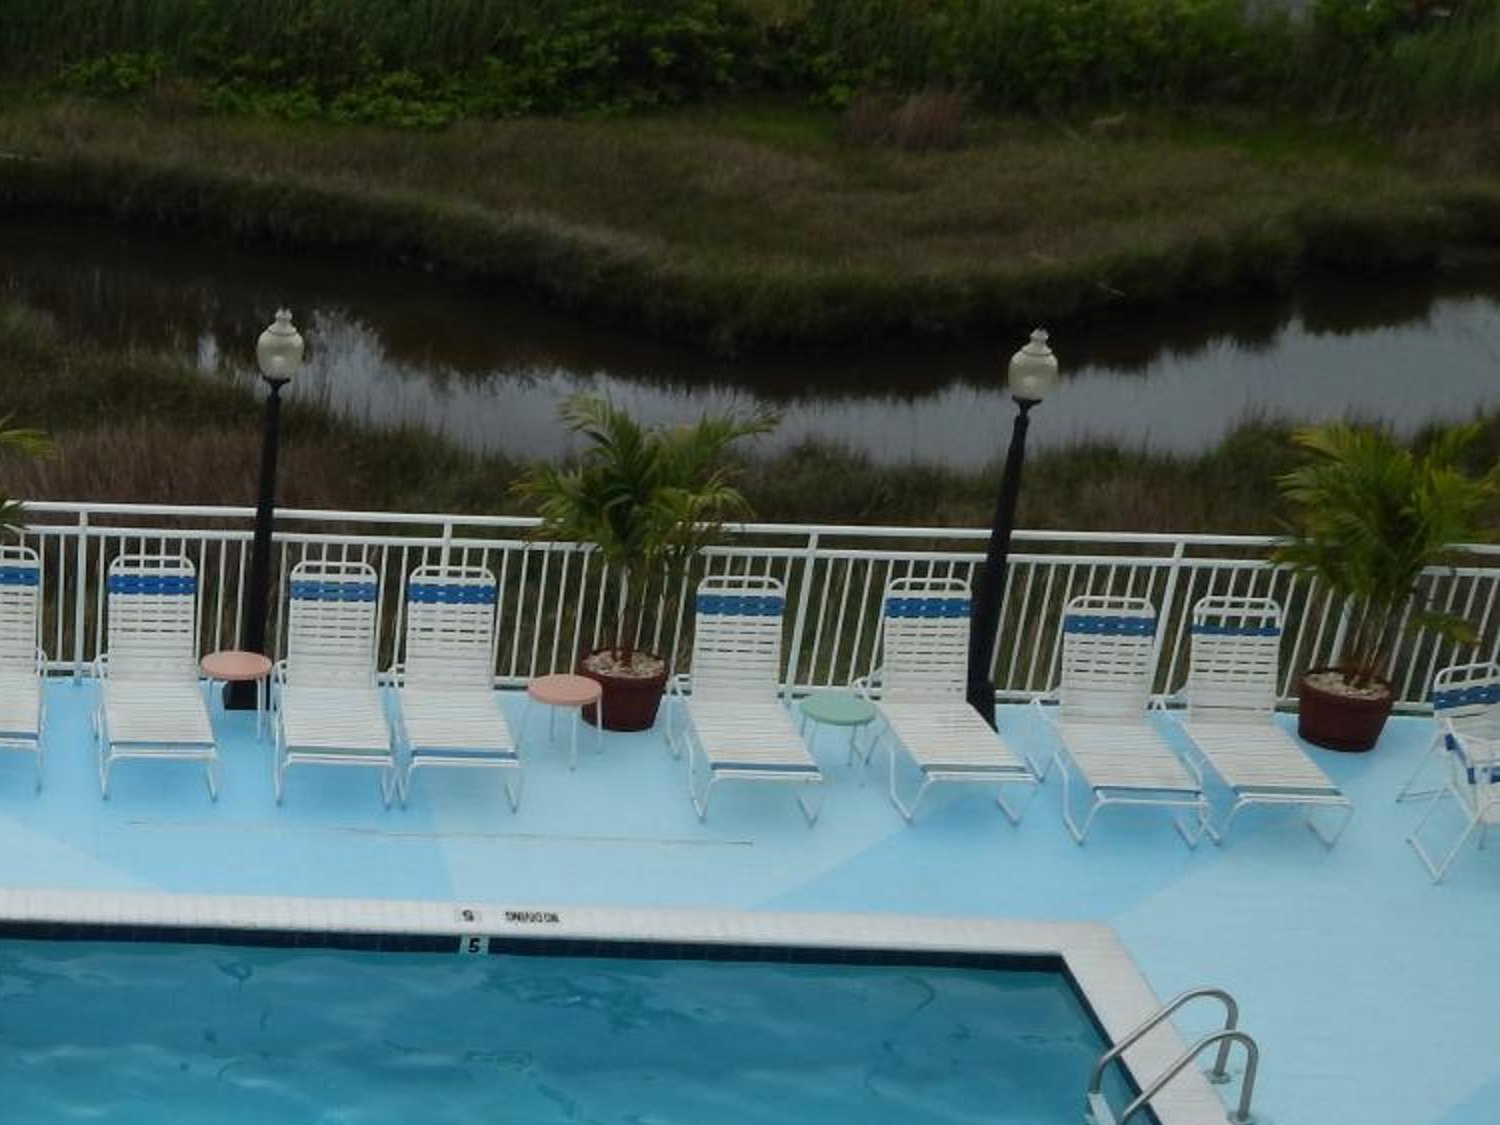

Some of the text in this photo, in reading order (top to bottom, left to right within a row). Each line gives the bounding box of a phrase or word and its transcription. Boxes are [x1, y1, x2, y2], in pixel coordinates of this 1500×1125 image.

[505, 911, 559, 923] NO DIVING
[468, 938, 480, 953] 5
